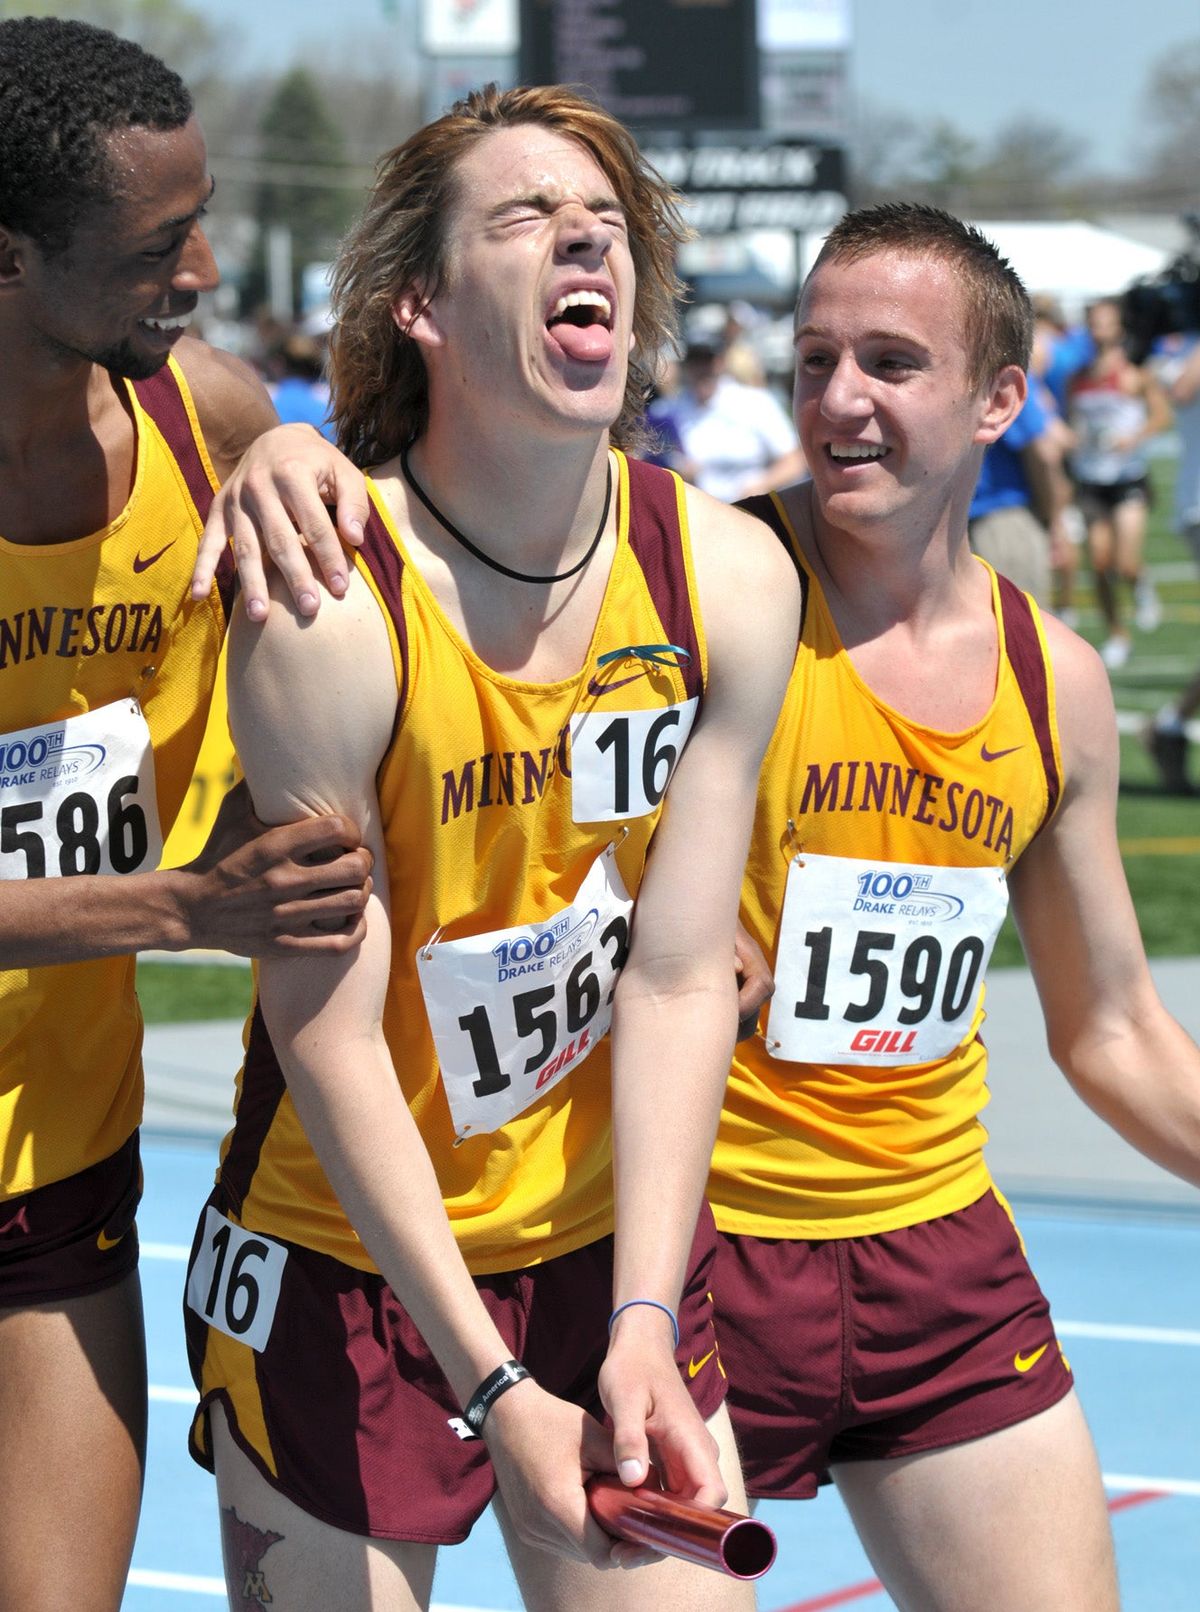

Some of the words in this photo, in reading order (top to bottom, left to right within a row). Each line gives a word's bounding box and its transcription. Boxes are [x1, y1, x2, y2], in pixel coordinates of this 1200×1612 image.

[0, 772, 36, 788] RAKE
[40, 761, 79, 780] RELAYS
[595, 710, 680, 813] 16
[799, 762, 1014, 854] MINNESOTA
[853, 898, 896, 914] DRAKE
[898, 904, 938, 917] RELAYS
[858, 871, 932, 900] 100TH
[493, 918, 569, 967] 100TH
[498, 961, 544, 982] DRAKE
[549, 936, 582, 968] RELAYS
[794, 926, 984, 1025] 1590
[535, 1028, 590, 1090] GILL
[850, 1029, 918, 1053] GILL
[204, 1224, 270, 1335] 16
